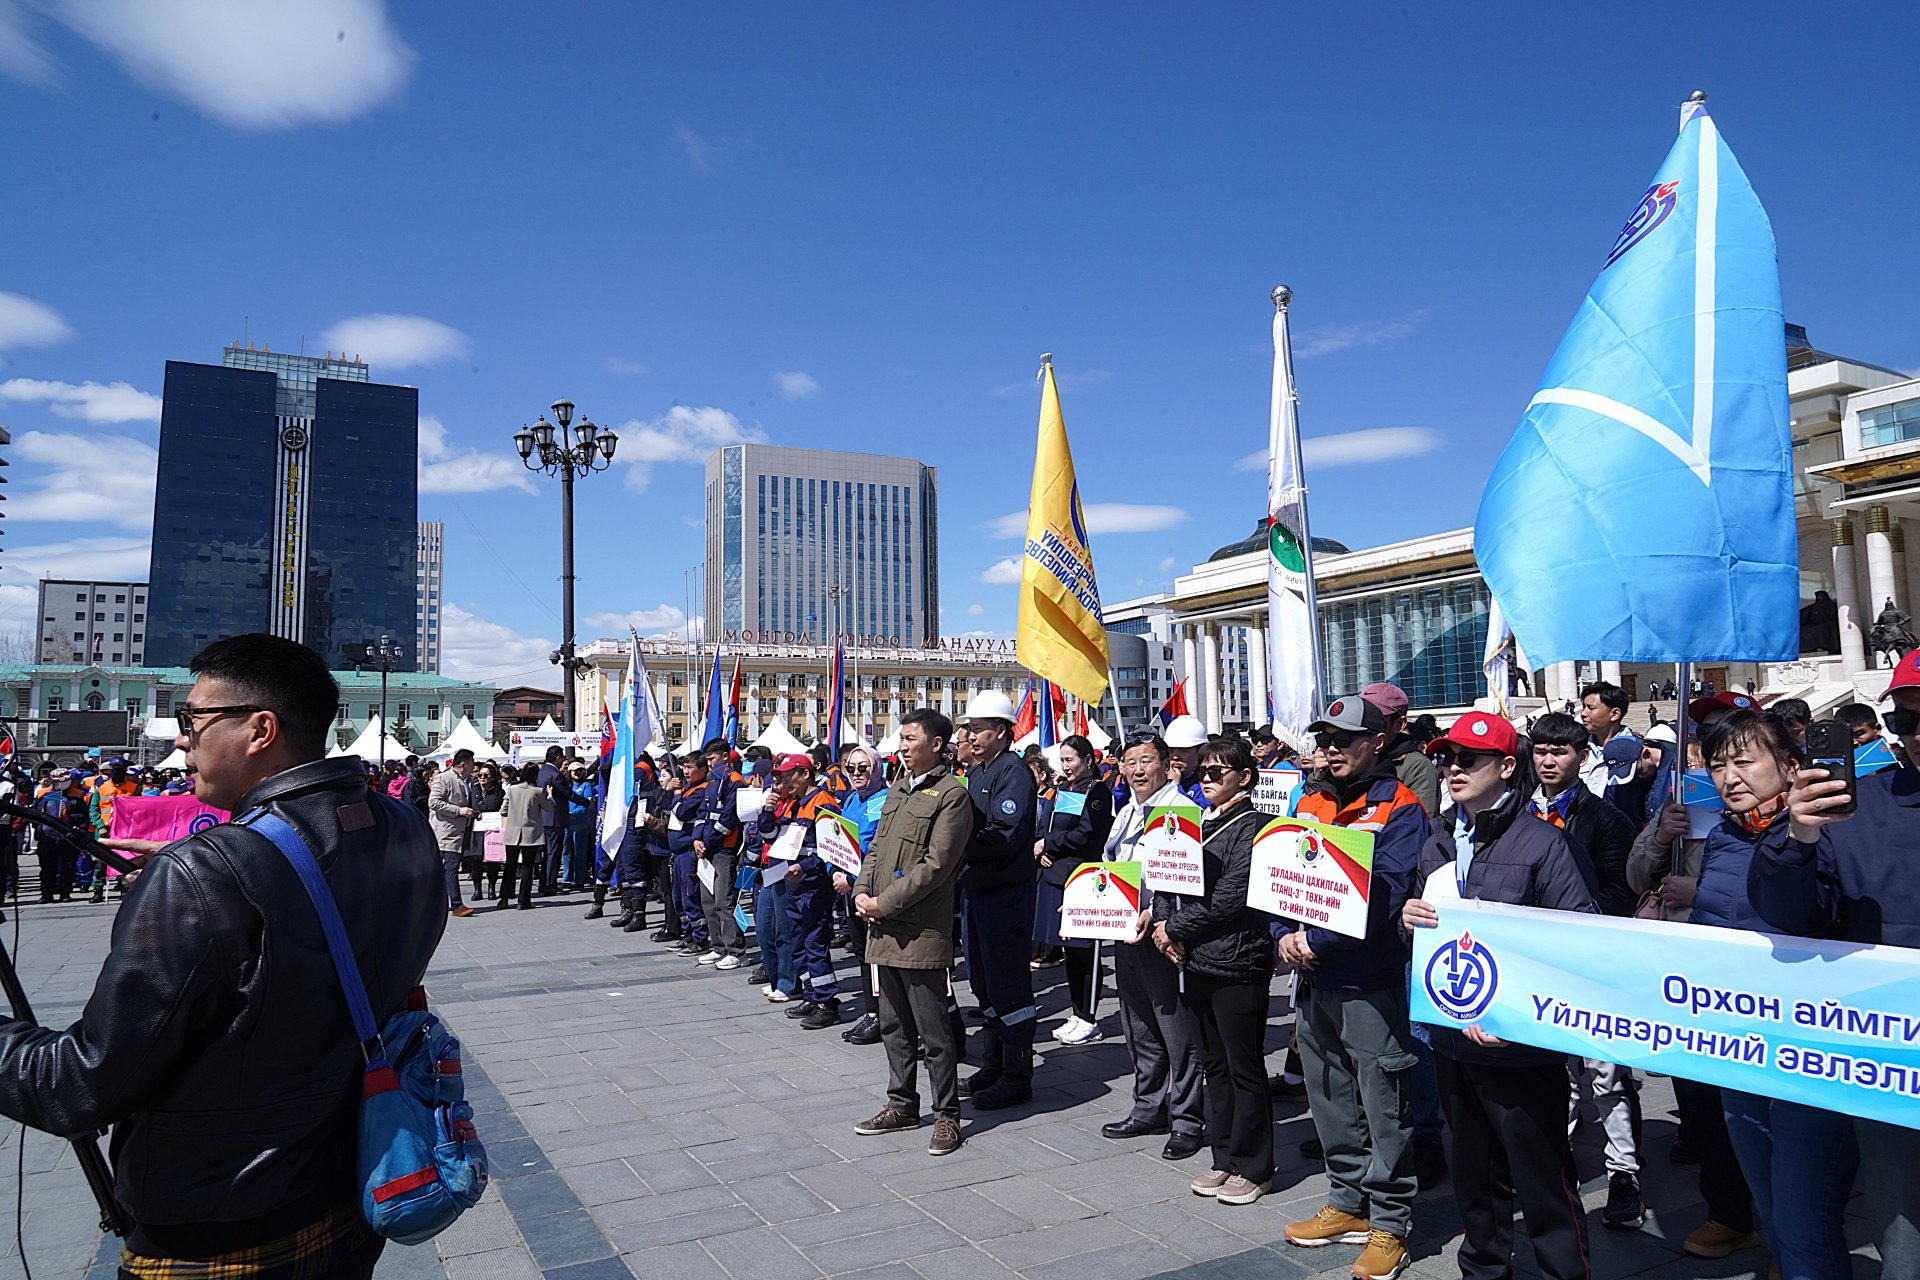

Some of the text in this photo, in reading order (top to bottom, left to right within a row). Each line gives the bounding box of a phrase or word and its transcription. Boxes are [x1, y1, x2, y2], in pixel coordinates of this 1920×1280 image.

[725, 628, 811, 644] МОНГОЛ
[1261, 789, 1288, 801] БАЙГАА
[1187, 875, 1201, 884] ХОРОО
[1306, 875, 1349, 895] ЦАХИЛГААН
[1305, 890, 1341, 910] ТӨХК-ИЙН
[1278, 899, 1329, 923] ҮЭ-ИЙН ХОРОО
[1111, 920, 1127, 929] ХОРОО
[1663, 975, 1780, 1021] Орхон
[1532, 994, 1767, 1066] Үйлдвэрчний
